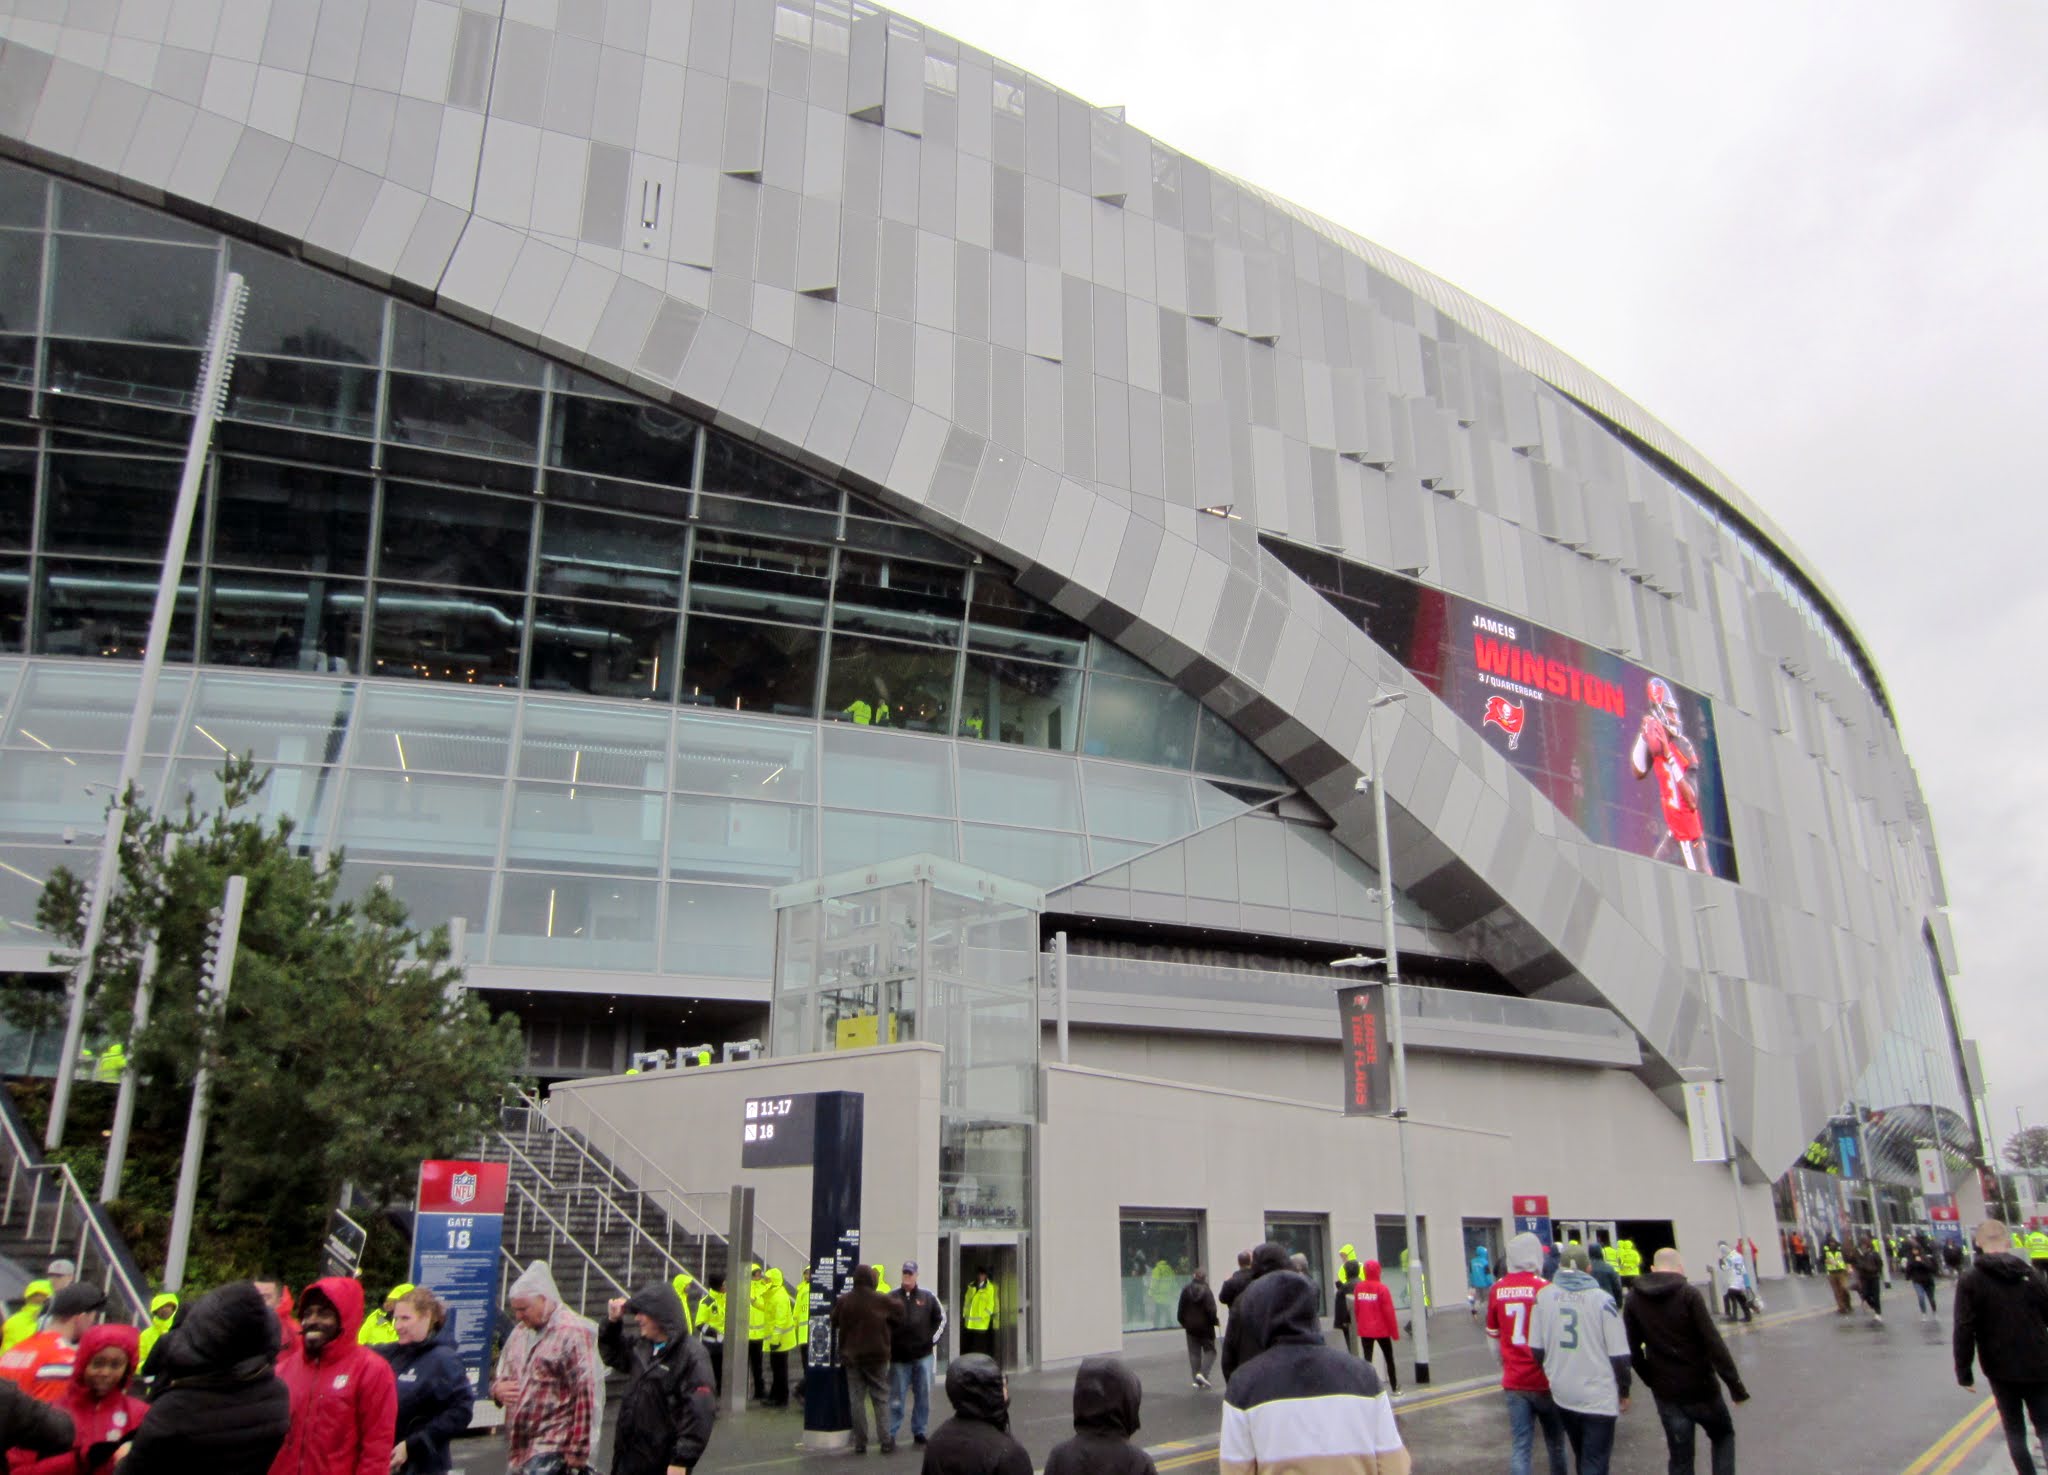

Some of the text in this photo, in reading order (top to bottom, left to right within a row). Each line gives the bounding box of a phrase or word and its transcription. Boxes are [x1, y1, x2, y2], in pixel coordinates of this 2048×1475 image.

[1472, 615, 1516, 640] JAMEIS
[1473, 634, 1626, 718] WINSTON
[1478, 672, 1485, 683] 3
[1490, 676, 1544, 701] QUARTERBACK
[760, 1100, 792, 1115] 11-17
[759, 1124, 774, 1139] 18
[454, 1185, 473, 1198] NFL
[447, 1217, 474, 1228] GATE
[1527, 1222, 1537, 1231] 17
[446, 1230, 471, 1249] 18
[1505, 1302, 1526, 1345] 7
[1559, 1308, 1579, 1349] 3
